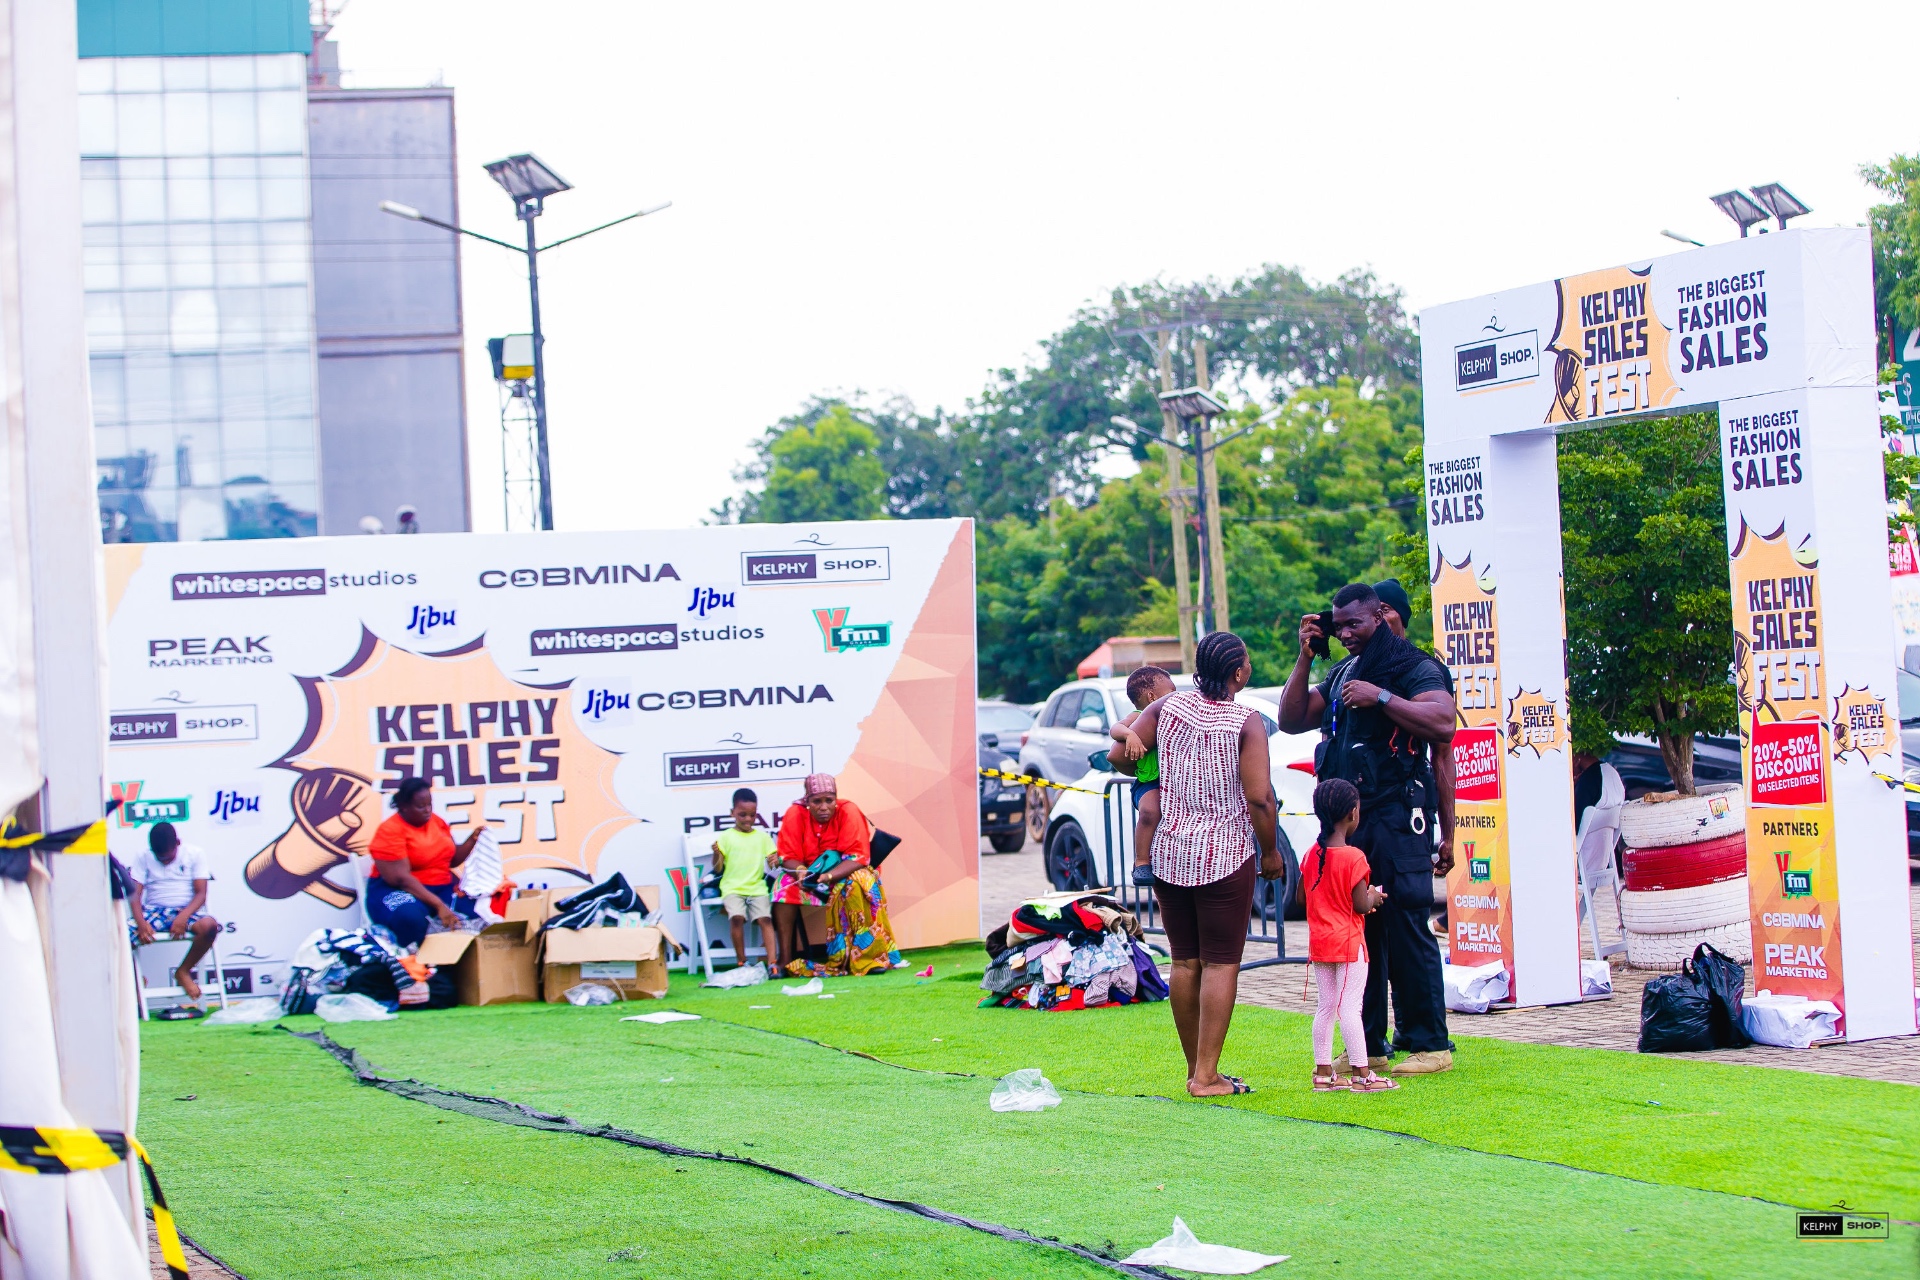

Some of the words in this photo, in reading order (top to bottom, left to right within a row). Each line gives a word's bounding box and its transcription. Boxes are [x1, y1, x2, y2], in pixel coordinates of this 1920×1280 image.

[1678, 283, 1703, 304] THE
[1707, 270, 1765, 298] BIGGEST
[1581, 282, 1646, 327] KELPHY
[1679, 291, 1767, 333] FASHION
[1583, 318, 1648, 366] SALES
[1681, 322, 1769, 373] SALES
[1460, 356, 1492, 376] KELPHY
[1500, 348, 1534, 366] SHOP.
[1585, 359, 1651, 418] FEST
[1729, 417, 1749, 433] THE
[1752, 410, 1798, 430] BIGGEST
[1730, 427, 1801, 458] FASHION
[1429, 462, 1444, 475] THE
[1446, 456, 1480, 473] BIGGEST
[1732, 452, 1802, 491] SALES
[1430, 471, 1482, 497] FASHION
[1431, 493, 1484, 526] SALES
[479, 563, 681, 588] COBMINA
[752, 563, 808, 575] KELPHY
[824, 559, 882, 570] SHOP.
[175, 575, 324, 596] whitespace
[329, 570, 418, 588] studios
[1748, 575, 1814, 612] KELPHY
[687, 587, 735, 616] Jibu
[407, 604, 456, 635] Jibu
[1443, 601, 1493, 631] KELPHY
[533, 631, 675, 650] whitespace
[681, 625, 765, 642] studios
[1752, 610, 1817, 651] SALES
[148, 635, 271, 657] PEAK
[1446, 631, 1495, 666] SALES
[149, 656, 273, 668] MARKETING
[1753, 652, 1820, 701] FEST
[582, 689, 630, 718] Jibu
[637, 684, 834, 711] COBMINA
[1522, 705, 1554, 716] KELPHY
[1849, 703, 1883, 716] KELPHY
[377, 698, 558, 742] KELPHY
[1523, 715, 1555, 728] SALES
[1850, 715, 1884, 731] SALES
[1524, 728, 1556, 744] FEST
[1754, 734, 1818, 762] 20%-50%
[1851, 730, 1886, 747] FEST
[1454, 739, 1495, 762] 0%-50%
[381, 739, 560, 789] SALES
[675, 761, 731, 776] KELPHY
[746, 758, 805, 770] SHOP.
[1455, 754, 1497, 778] ISCOUNT
[1755, 753, 1820, 780] DISCOUNT
[1457, 775, 1481, 789] SELECTED
[1481, 774, 1497, 784] ITEMS
[1757, 783, 1767, 793] ON
[1767, 776, 1799, 792] SELECTED
[1799, 774, 1819, 786] ITEMS
[209, 790, 260, 820] Jibu
[381, 785, 565, 844] EST
[1455, 815, 1496, 829] PARTNERS
[1763, 822, 1819, 836] PARTNERS
[1456, 922, 1501, 943] PEAK
[1457, 941, 1502, 954] MARKETING
[1764, 943, 1826, 968] PEAK
[1765, 966, 1828, 980] MARKETING
